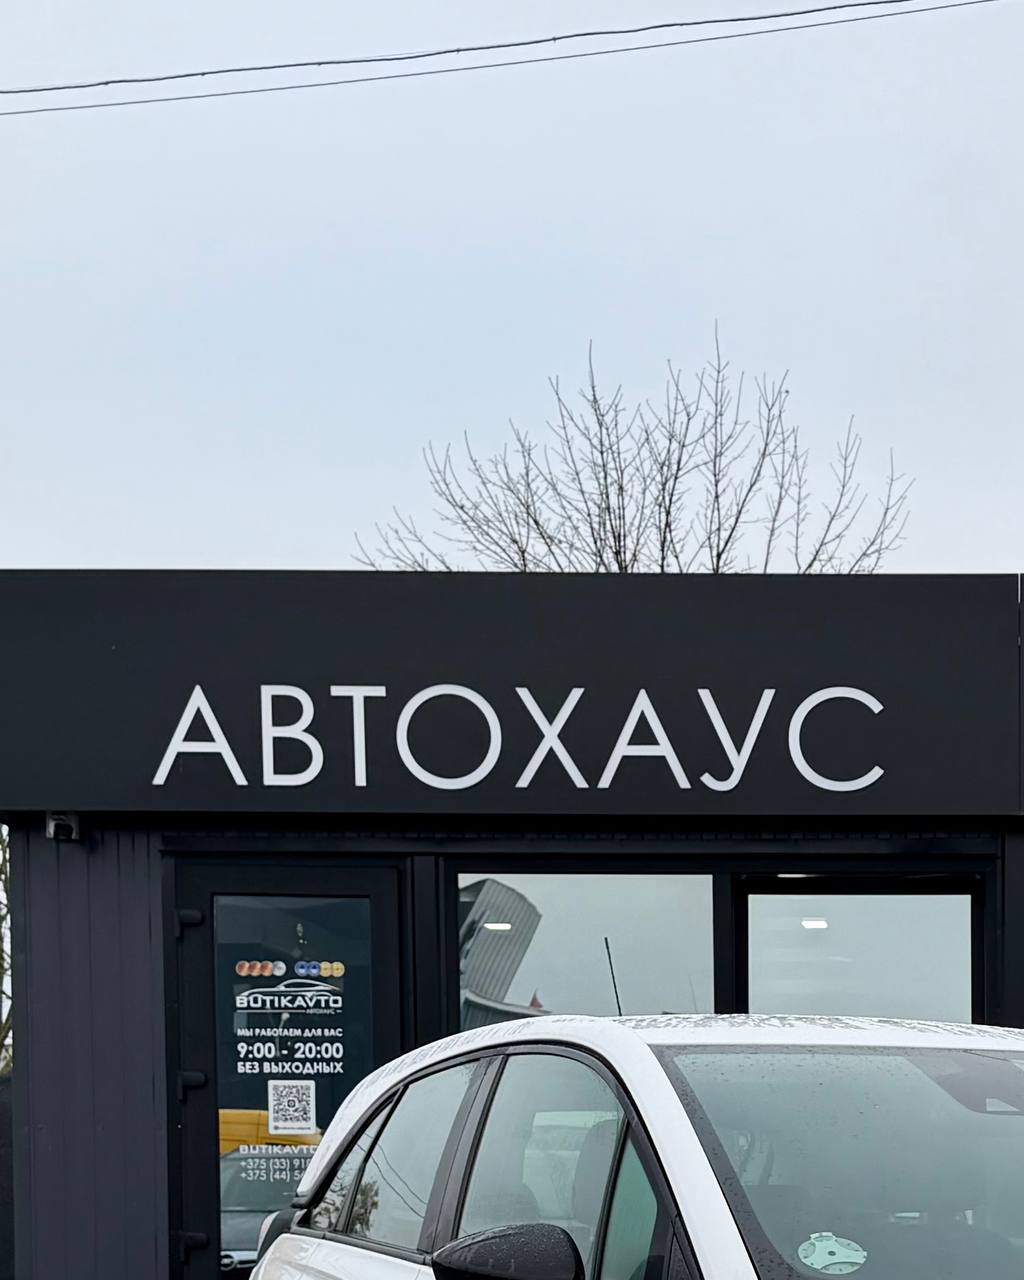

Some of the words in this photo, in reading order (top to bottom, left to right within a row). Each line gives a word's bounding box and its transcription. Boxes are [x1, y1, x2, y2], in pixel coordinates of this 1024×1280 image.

[152, 683, 885, 793] АВТОХАУС
[235, 995, 343, 1008] BUTIKAVTO
[237, 1028, 253, 1037] МЫ
[255, 1028, 302, 1037] РАБОТАЕМ
[303, 1028, 322, 1037] ДЛЯ
[324, 1028, 343, 1037] ВАС
[237, 1042, 276, 1059] 9:00
[294, 1042, 344, 1059] 20:00
[237, 1062, 260, 1074] БЕЗ
[263, 1062, 344, 1075] ВЫХОДНЫХ
[240, 1158, 267, 1169] +375
[269, 1158, 290, 1170] (33)
[240, 1170, 267, 1180] +375
[269, 1170, 290, 1182] (44)
